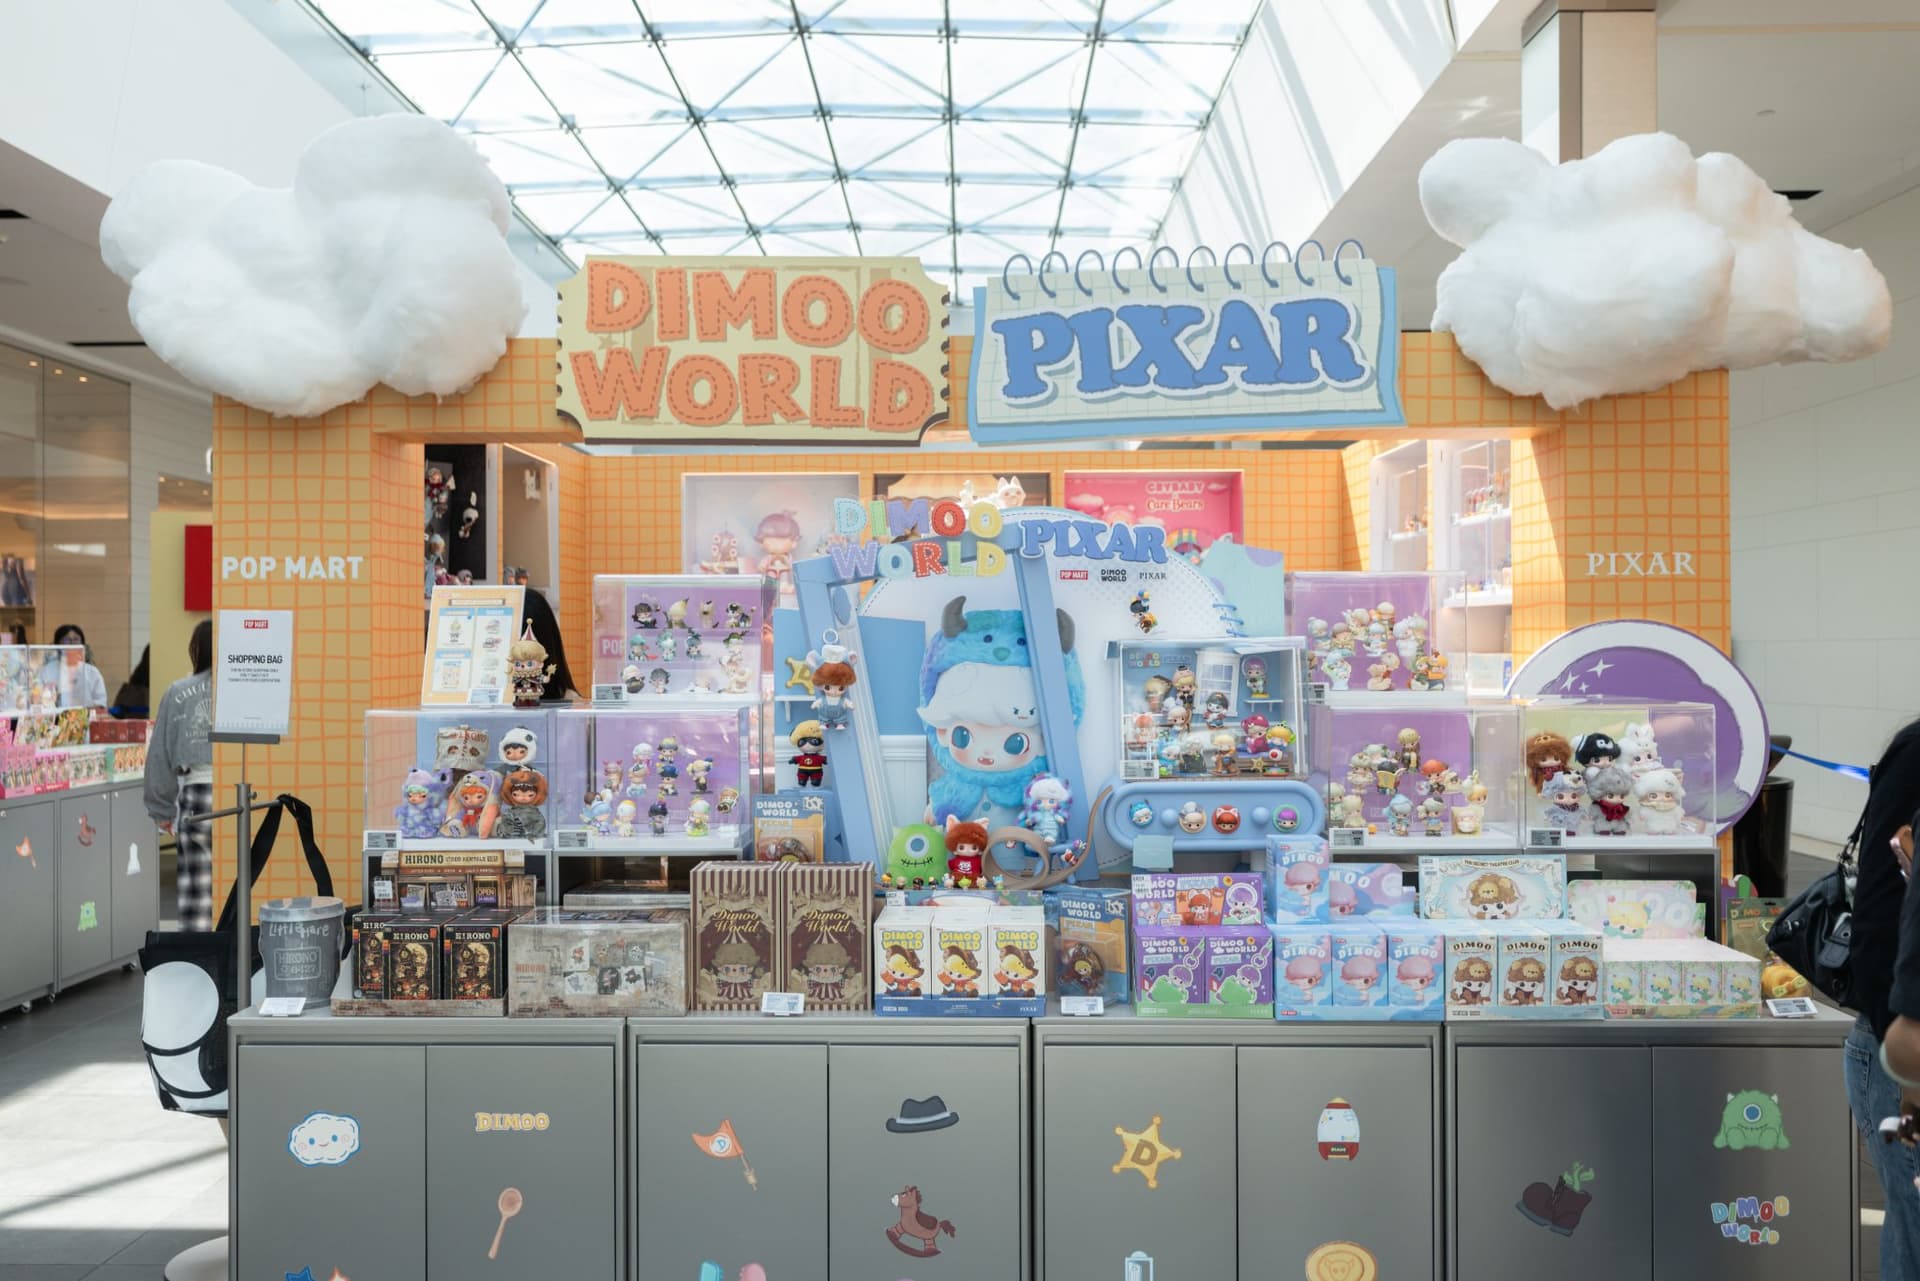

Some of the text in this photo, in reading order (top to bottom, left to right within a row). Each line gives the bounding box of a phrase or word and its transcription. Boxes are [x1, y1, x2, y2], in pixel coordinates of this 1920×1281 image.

[586, 260, 931, 354] DIMOO
[991, 298, 1366, 399] PIXAR
[568, 345, 936, 432] WORLD
[833, 497, 1004, 539] DIMOO
[1021, 519, 1169, 564] PIXAR
[829, 540, 1006, 578] WORLD
[1584, 551, 1696, 577] PIXAR
[222, 556, 364, 580] POP MART
[1061, 566, 1087, 580] POP MART
[1101, 564, 1127, 576] DIMOO
[1140, 567, 1167, 580] PIXAR
[1101, 575, 1127, 583] WORLD
[228, 654, 283, 664] SHOPPING BAG
[756, 801, 793, 809] DIMOO
[762, 808, 799, 817] WORLD
[405, 855, 444, 865] HIRONO
[1282, 852, 1325, 865] DIMOO
[1062, 899, 1096, 911] DIMOO
[1066, 908, 1102, 920] WORLD
[882, 931, 923, 941] DIMOO
[940, 932, 981, 942] DIMOO
[997, 931, 1038, 941] DIMOO
[1142, 940, 1177, 948] DIMOO
[1210, 940, 1244, 948] DIMOO
[1453, 940, 1492, 951] DIMOO
[1507, 941, 1546, 951] DIMOO
[1559, 940, 1599, 950] DIMOO
[475, 1112, 550, 1132] DIMOO
[1131, 1138, 1159, 1166] D
[1710, 1196, 1790, 1224] DIMOO
[1720, 1222, 1780, 1245] WORLD
